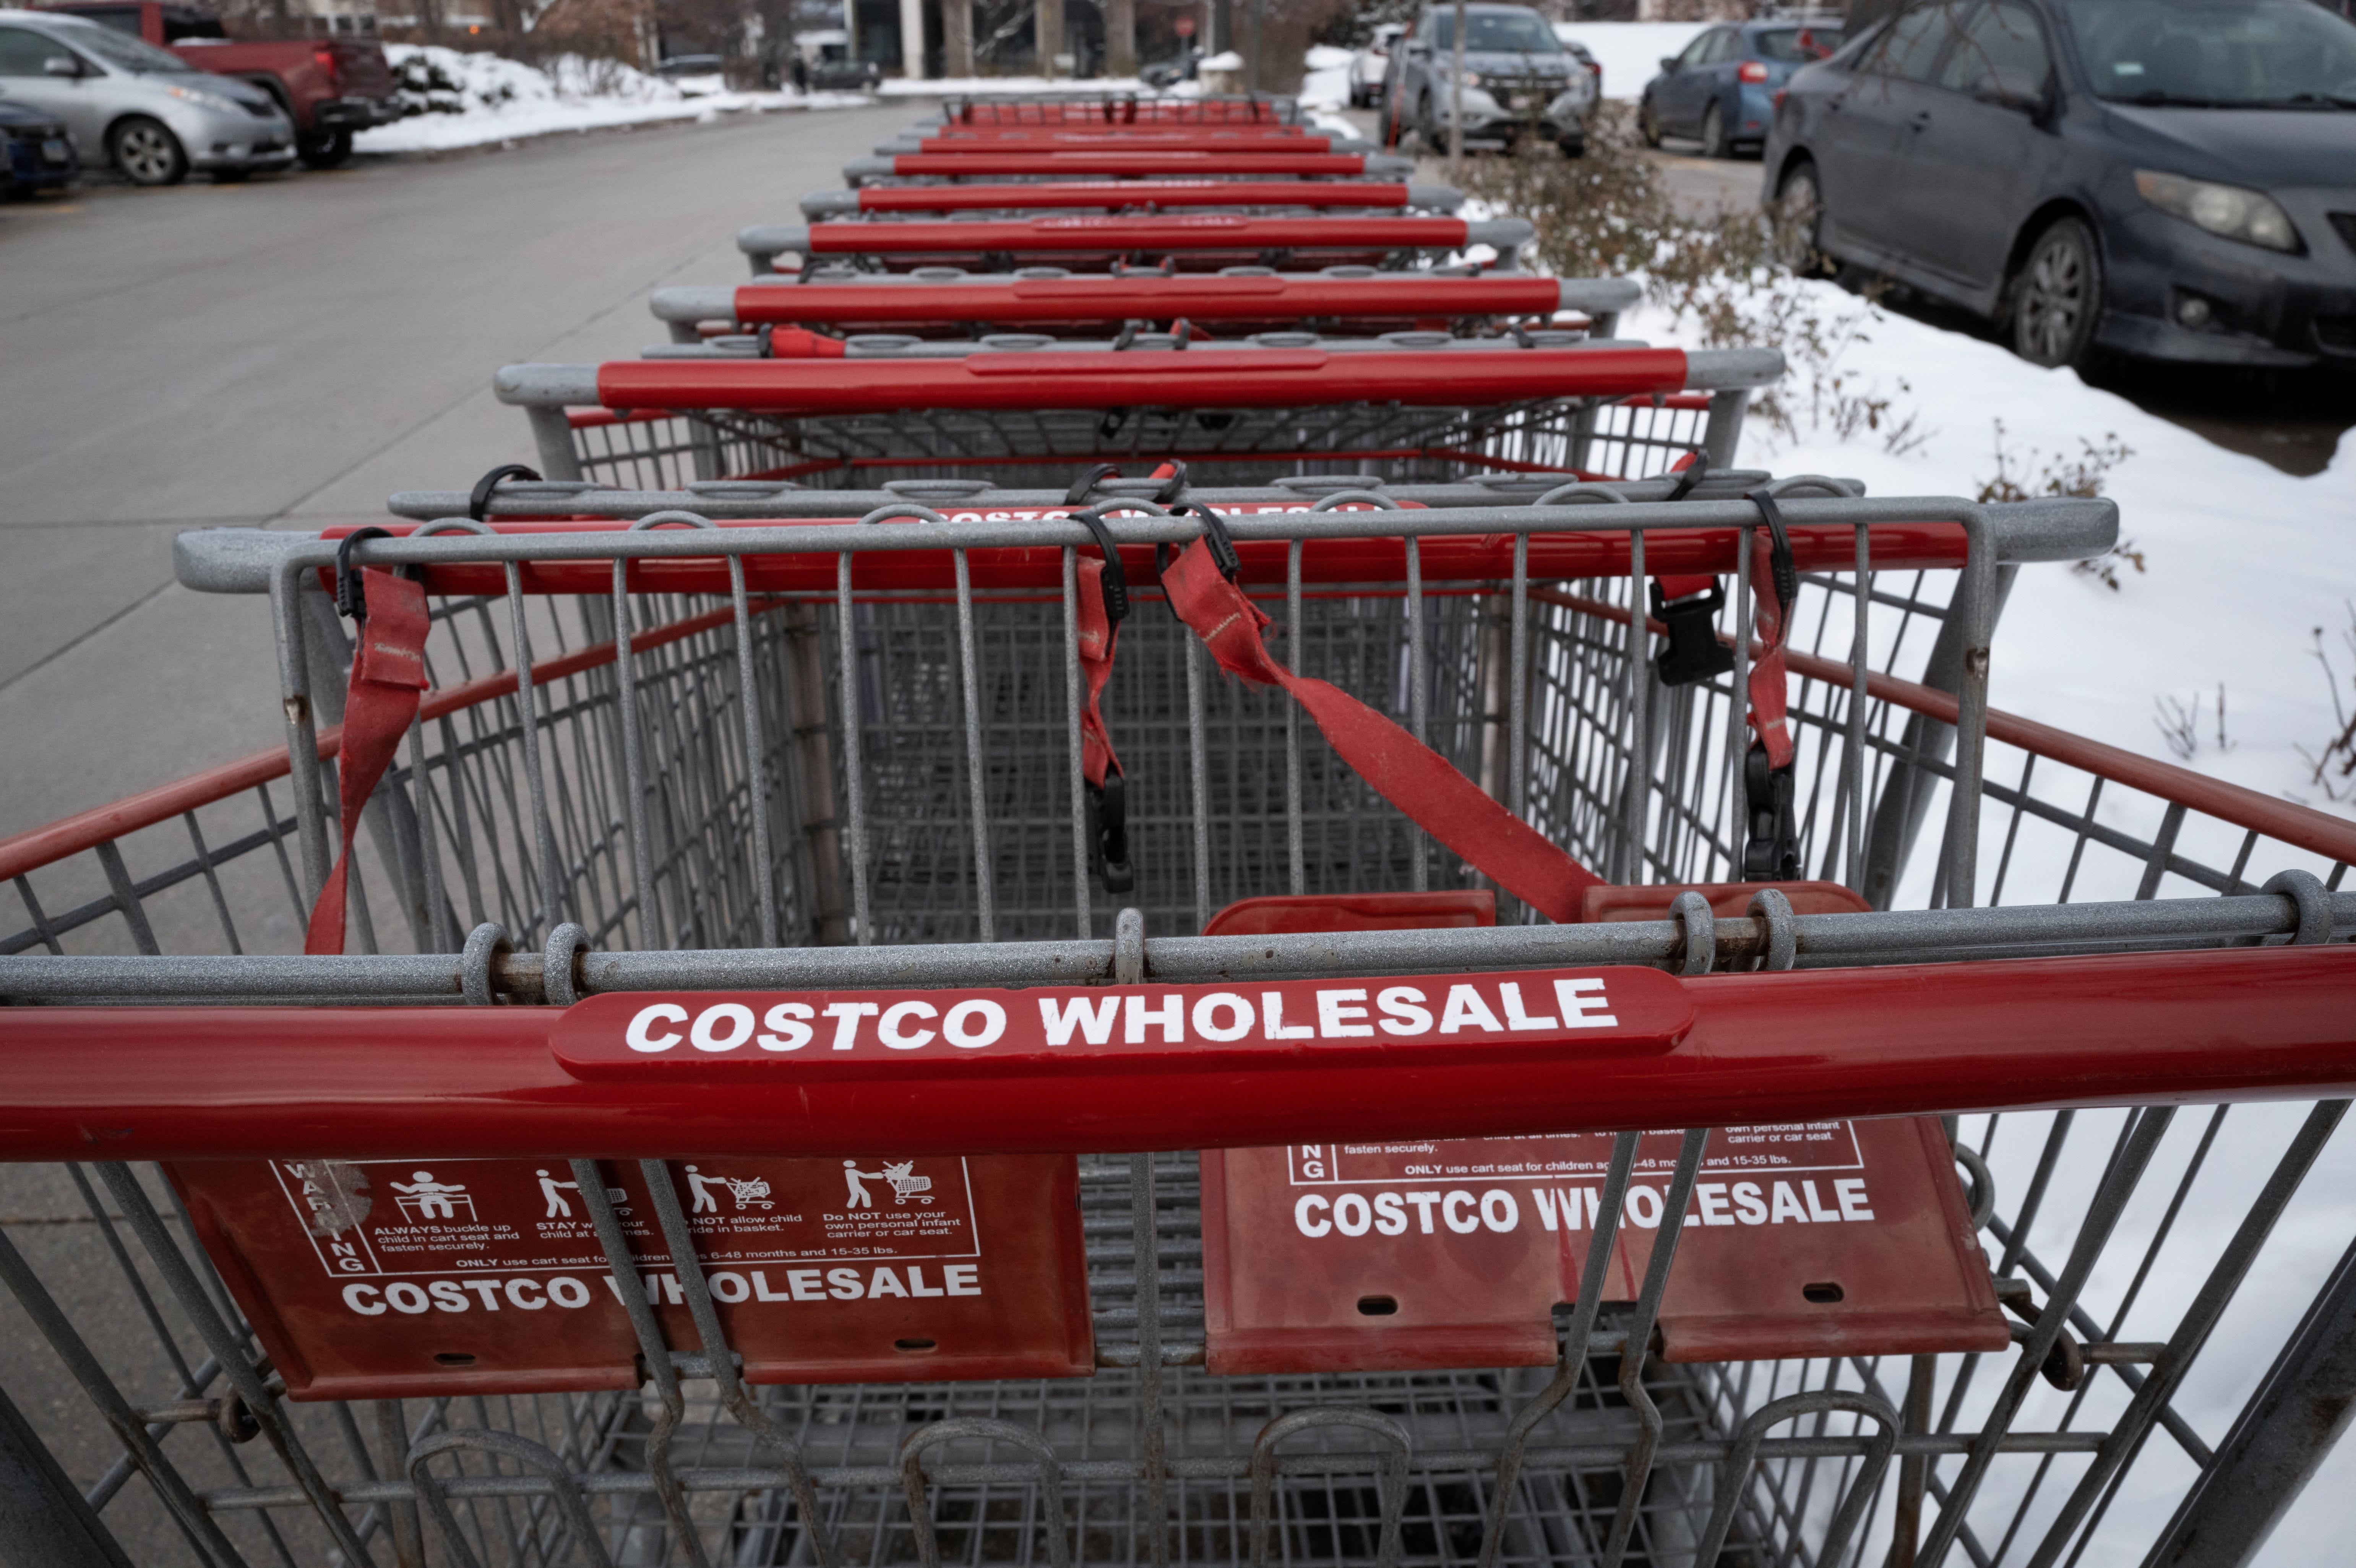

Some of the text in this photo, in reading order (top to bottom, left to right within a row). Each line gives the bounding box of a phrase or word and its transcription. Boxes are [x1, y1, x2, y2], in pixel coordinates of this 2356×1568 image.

[626, 977, 1619, 1052] COSTCO WHOLESALE
[1753, 1123, 1804, 1133] personal
[1806, 1122, 1840, 1130] infant
[1728, 1134, 1766, 1143] carrier
[1344, 1143, 1438, 1154] fasten securely.
[1405, 1165, 1442, 1175] ONLY
[1471, 1164, 1494, 1173] cart
[1498, 1163, 1523, 1172] seat
[1526, 1162, 1542, 1172] for
[1545, 1161, 1593, 1171] children
[1707, 1156, 1729, 1165] and
[1732, 1155, 1767, 1165] 15-35
[1769, 1154, 1791, 1164] lbs.
[848, 1212, 881, 1221] NOT
[915, 1211, 946, 1219] your
[1295, 1189, 1519, 1237] COSTCO
[693, 1217, 725, 1225] NOT
[770, 1214, 802, 1222] child
[858, 1220, 918, 1230] personal
[922, 1218, 961, 1227] infant
[374, 1226, 441, 1235] ALWAYS
[443, 1224, 489, 1233] buckle
[536, 1222, 577, 1230] STAY
[733, 1224, 784, 1232] basket.
[827, 1230, 871, 1238] carrier
[919, 1227, 952, 1235] seat.
[378, 1235, 409, 1243] child
[428, 1242, 490, 1251] securely.
[456, 1259, 498, 1268] ONLY
[711, 1251, 742, 1259] 6-48
[746, 1250, 797, 1258] months
[800, 1248, 826, 1256] and
[831, 1247, 870, 1255] 15-35
[874, 1246, 898, 1254] lbs.
[342, 1277, 591, 1315] COSTCO
